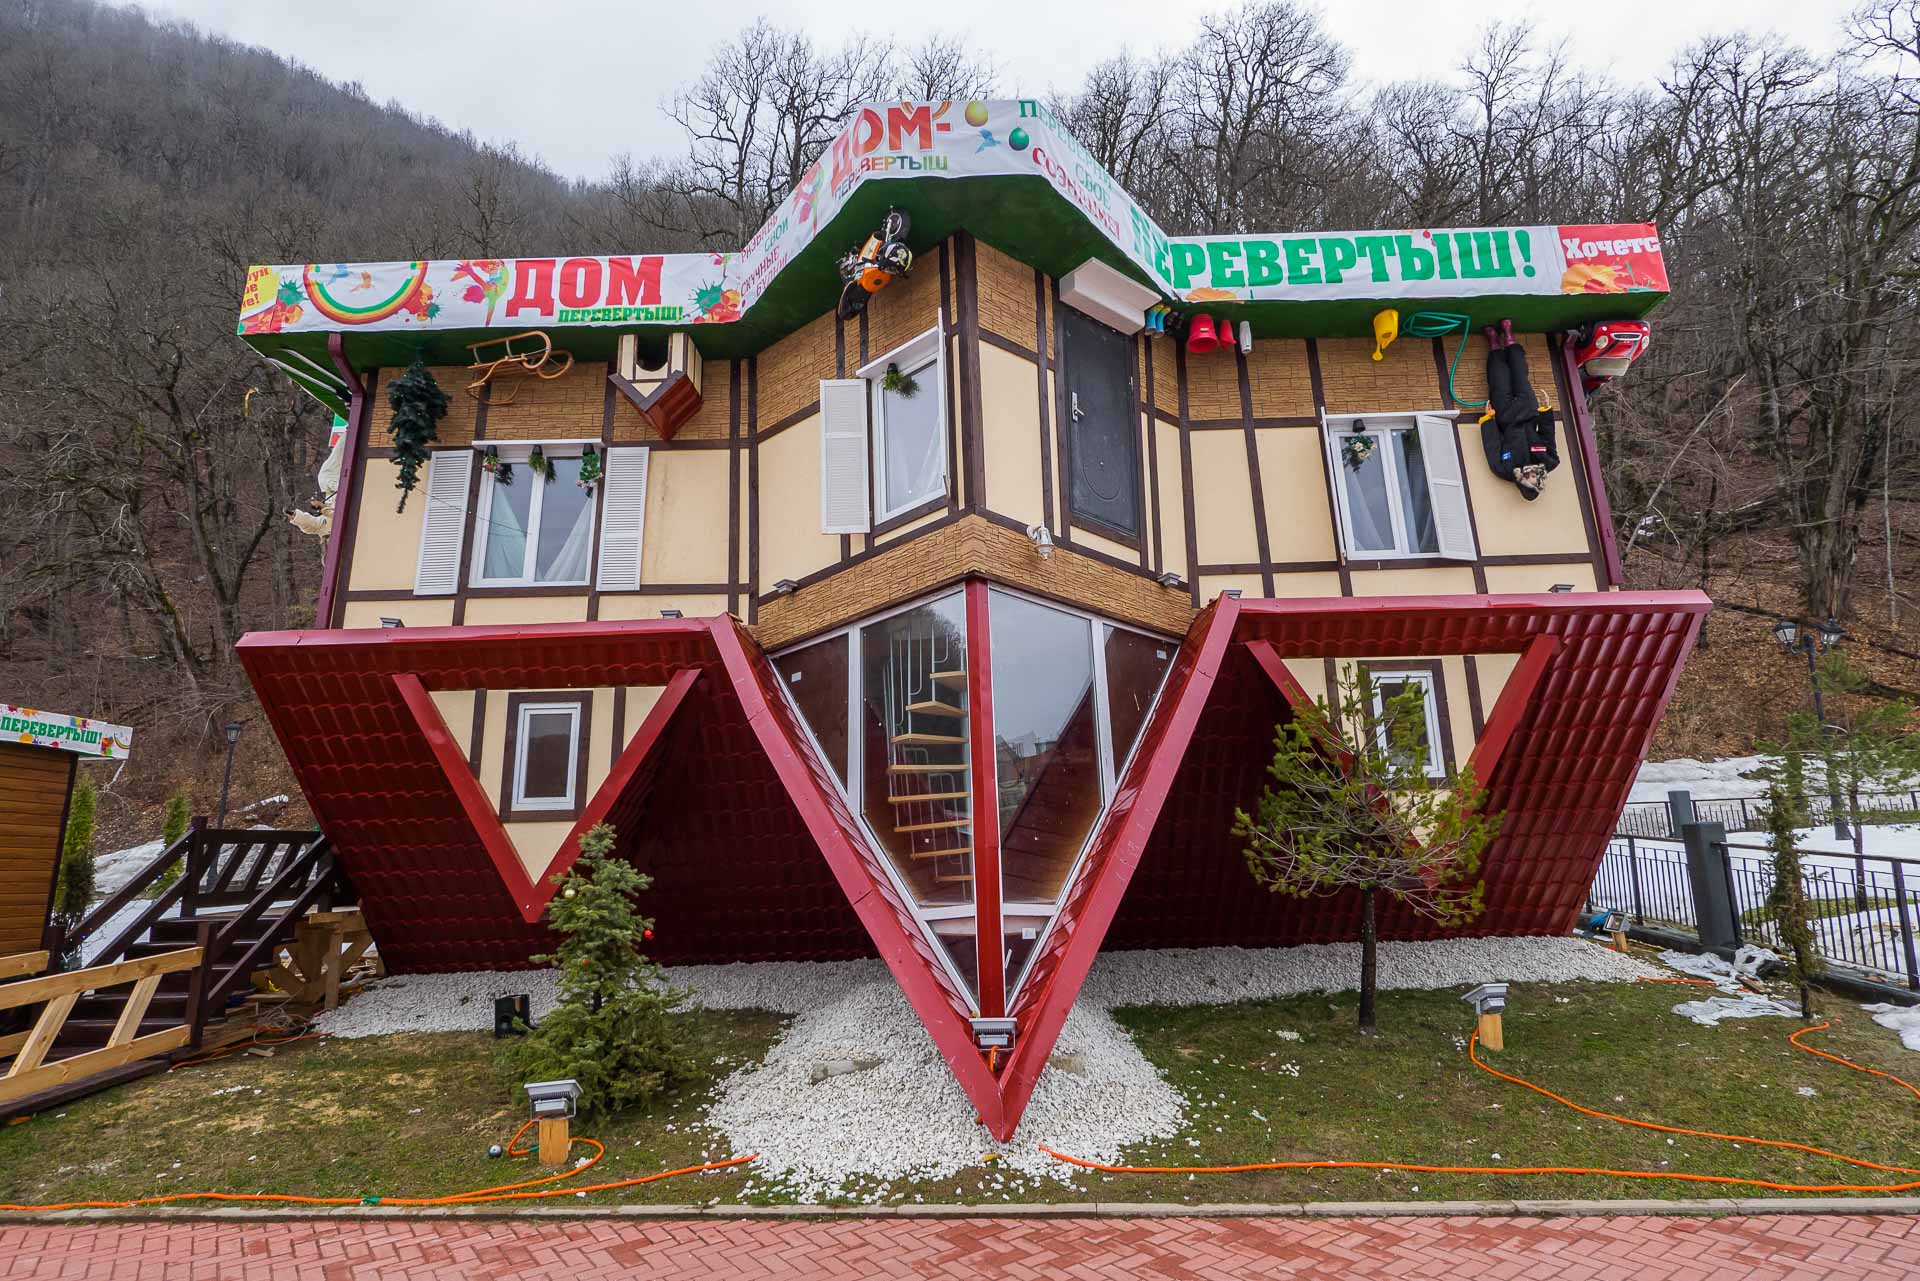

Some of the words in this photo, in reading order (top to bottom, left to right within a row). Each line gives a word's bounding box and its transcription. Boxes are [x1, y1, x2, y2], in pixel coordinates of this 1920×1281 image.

[1131, 205, 1536, 289] ПЕРЕВЕРТЫШ!
[505, 256, 664, 317] ДОМ
[557, 305, 684, 323] ПЕРЕВЕРТЫШ!
[0, 716, 103, 744] ПЕРЕВЕРТЫШ!
